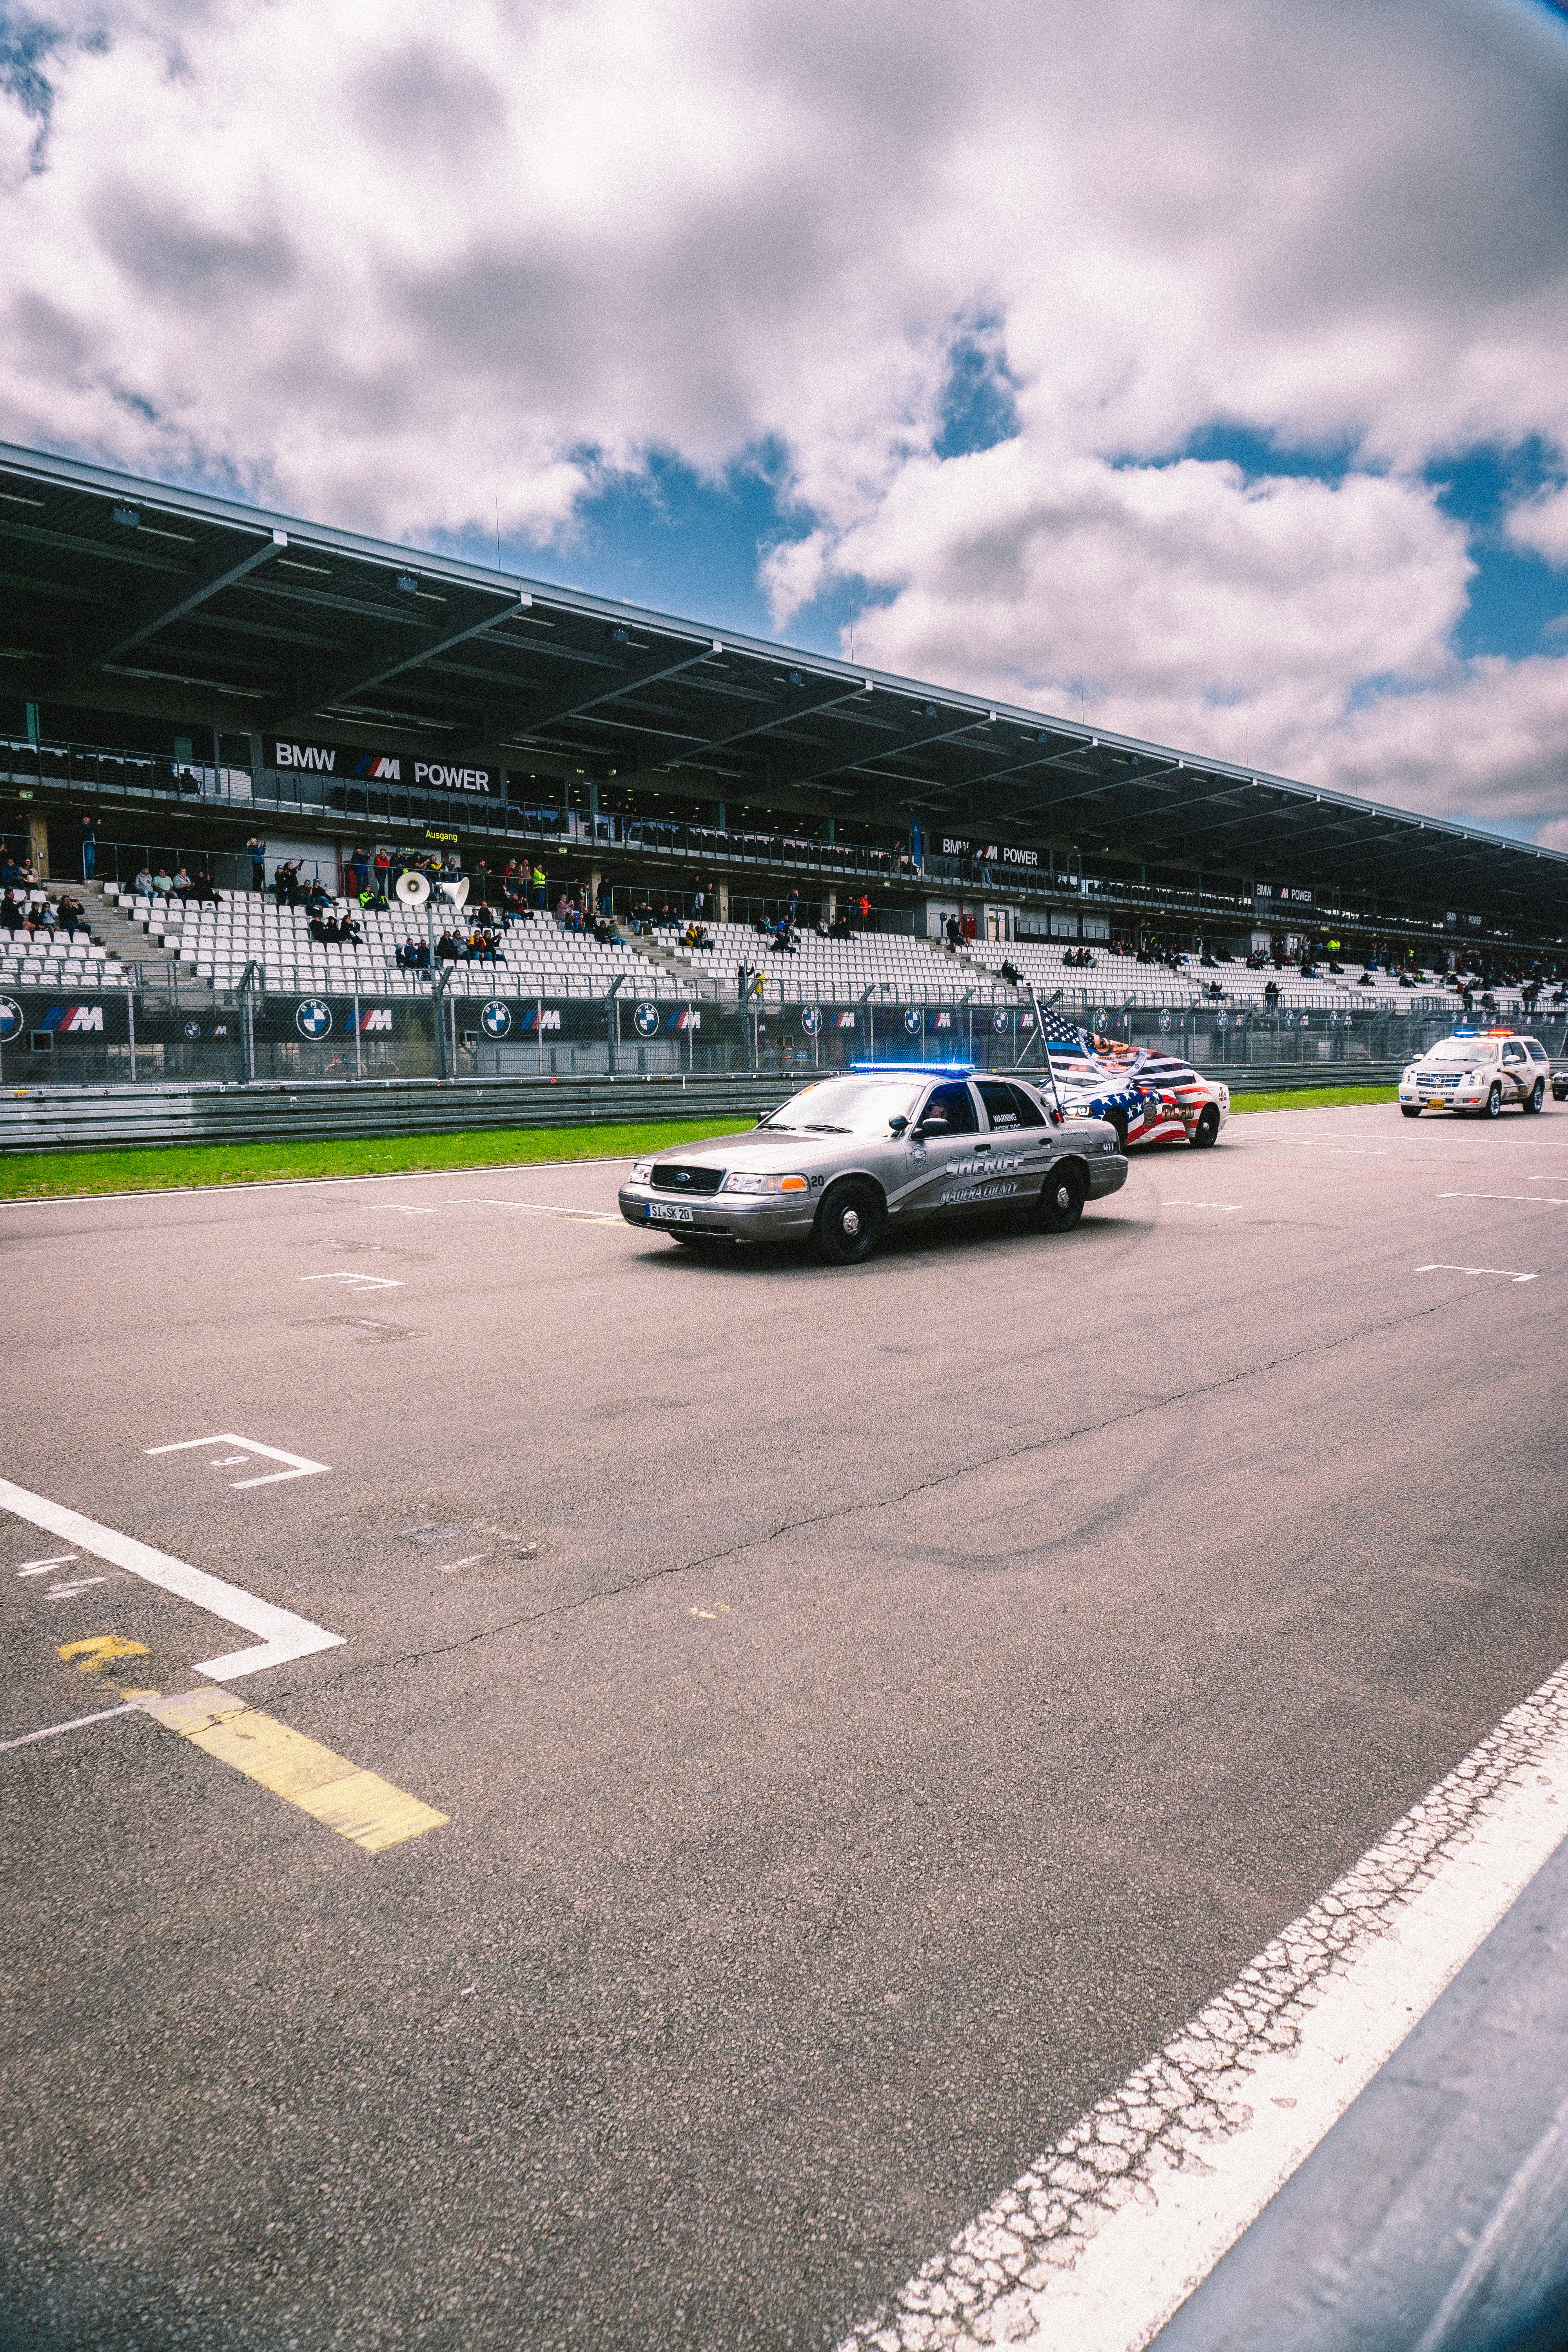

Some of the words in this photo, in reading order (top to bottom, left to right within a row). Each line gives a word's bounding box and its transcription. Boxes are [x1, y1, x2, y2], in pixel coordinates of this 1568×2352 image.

[276, 743, 335, 771] BMW
[374, 757, 400, 779] M
[415, 762, 489, 791] POWER
[426, 829, 457, 842] Ausgang
[1004, 848, 1038, 865] POWER
[1257, 884, 1272, 896] BMW
[1292, 889, 1311, 901] POWER
[1468, 915, 1482, 924] POWER
[300, 1002, 327, 1013] BMW
[68, 1007, 103, 1030] M
[365, 1010, 392, 1030] M
[537, 1011, 560, 1029] M
[993, 1113, 1017, 1123] WARNING
[1103, 1141, 1114, 1152] 911
[945, 1151, 1024, 1179] SHERIFF
[811, 1175, 824, 1187] 20
[940, 1186, 982, 1204] MADERA
[983, 1181, 1019, 1198] COUNTY
[652, 1206, 662, 1216] SI
[667, 1208, 677, 1218] SK
[679, 1209, 690, 1219] 20
